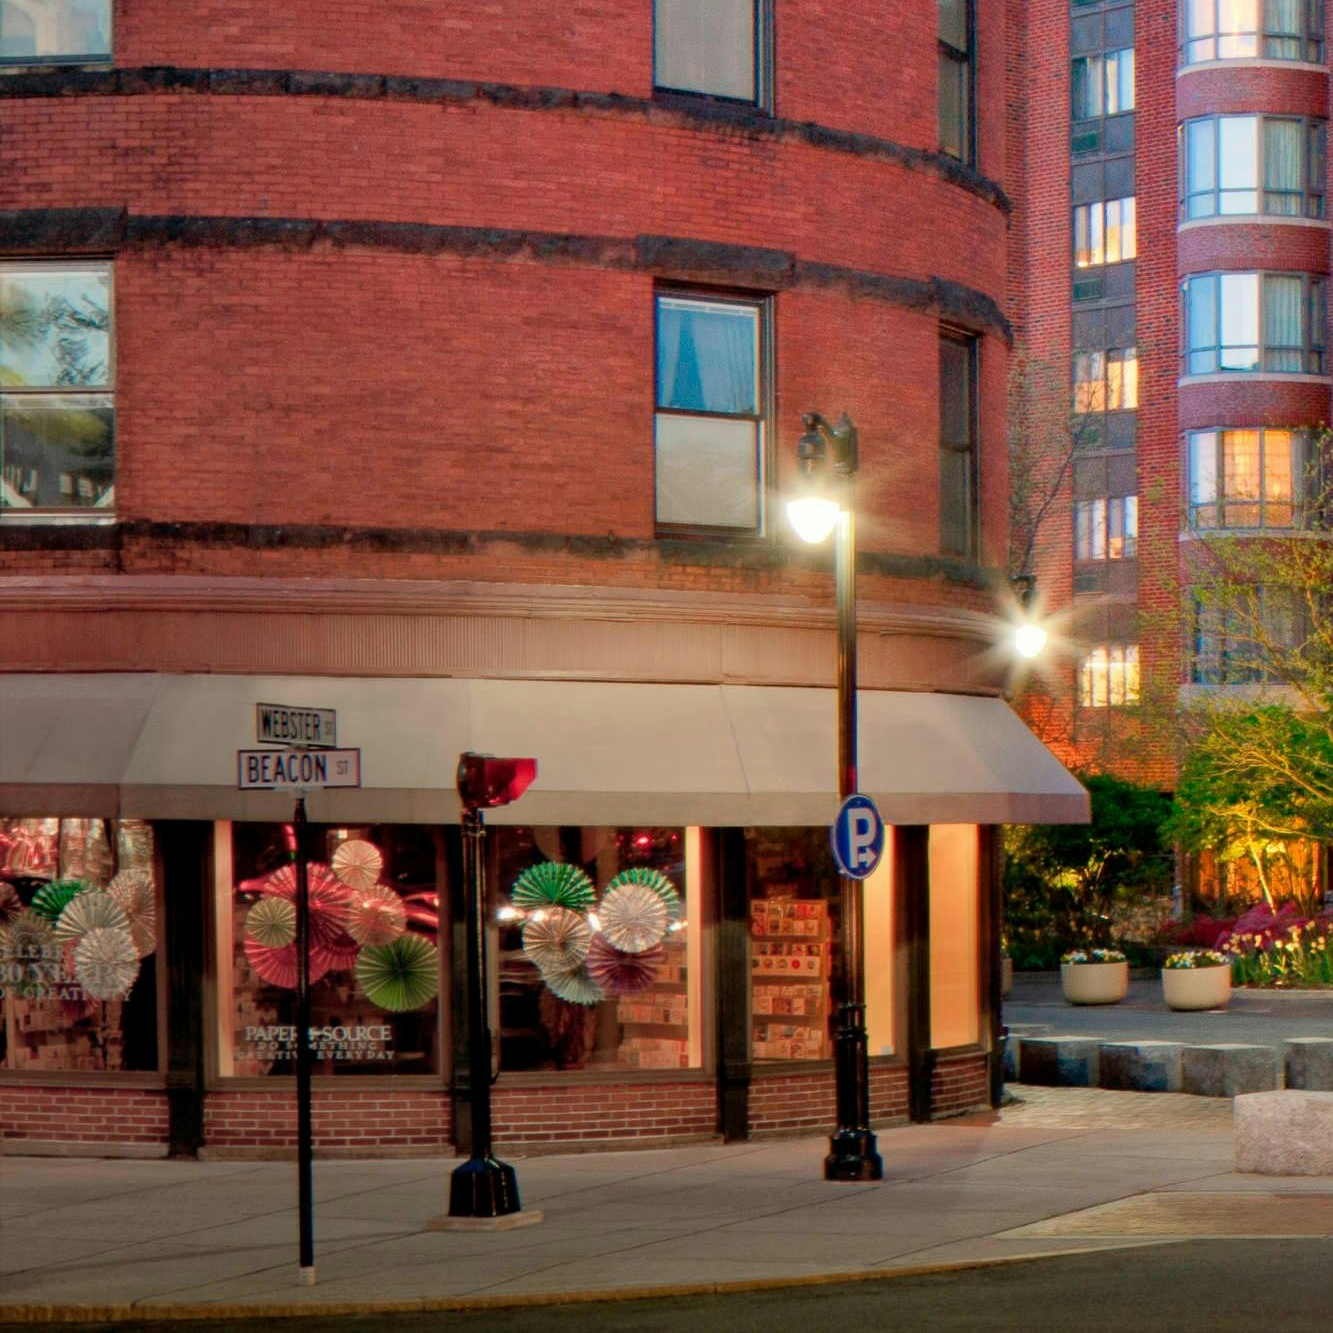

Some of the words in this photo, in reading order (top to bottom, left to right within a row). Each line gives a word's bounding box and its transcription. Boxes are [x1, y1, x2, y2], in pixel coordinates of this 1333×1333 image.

[261, 708, 321, 740] WEBSTER
[247, 753, 327, 783] BEACON
[336, 760, 349, 775] ST
[848, 808, 877, 869] P
[321, 1025, 393, 1041] SOURCE
